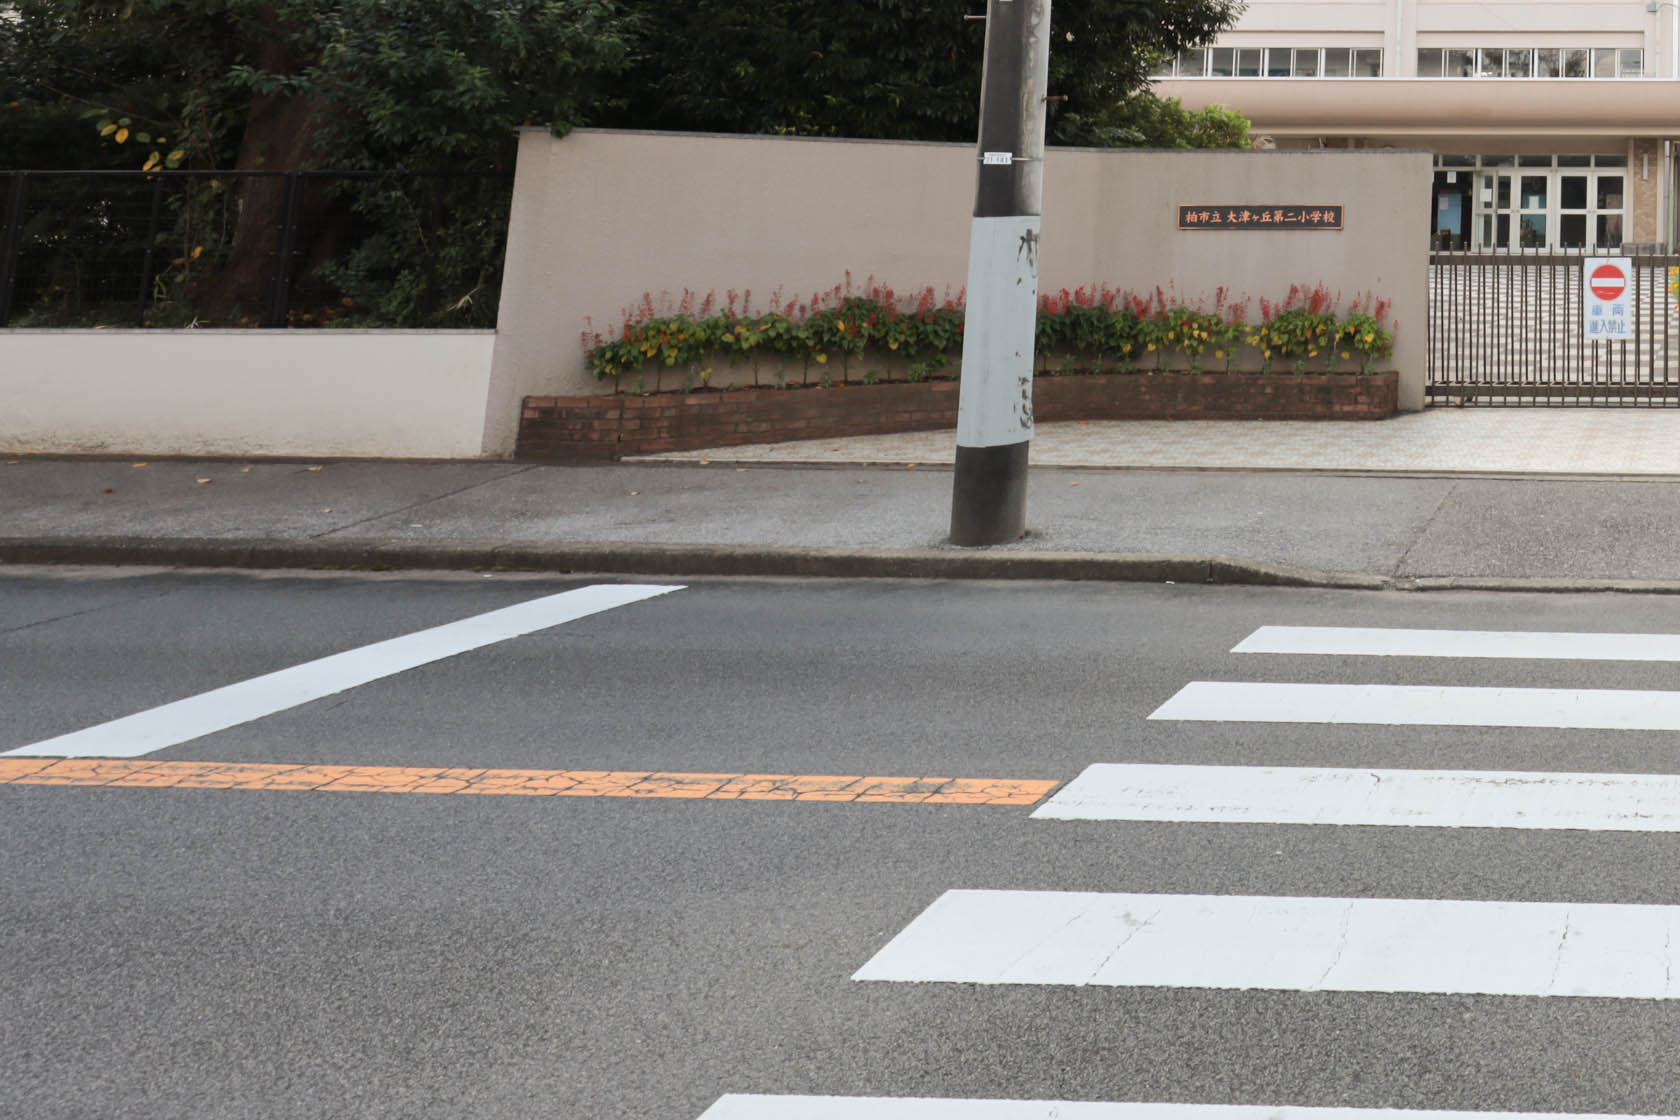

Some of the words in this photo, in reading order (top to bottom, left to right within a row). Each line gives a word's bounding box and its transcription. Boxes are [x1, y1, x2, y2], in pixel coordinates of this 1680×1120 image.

[1185, 210, 1222, 224] 柏市立
[1589, 319, 1627, 334] 進入禁止
